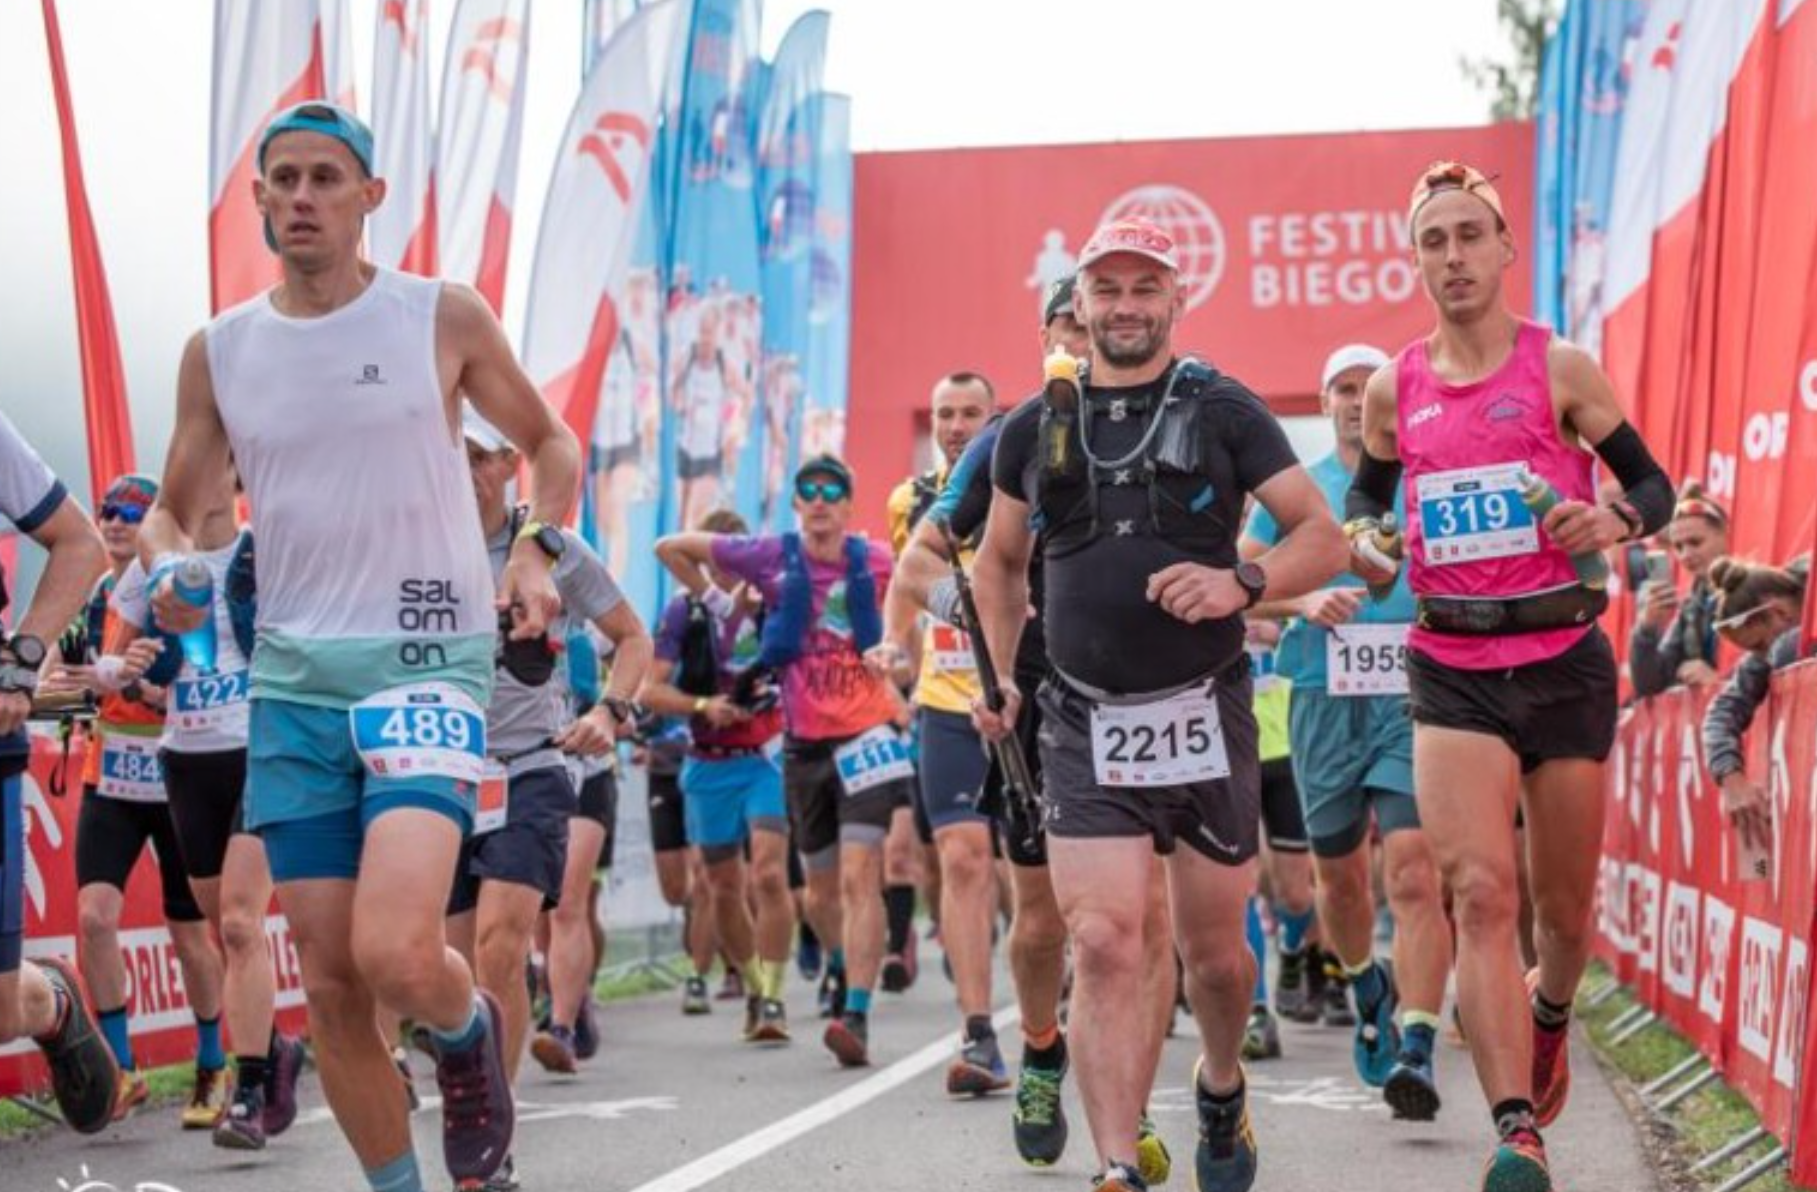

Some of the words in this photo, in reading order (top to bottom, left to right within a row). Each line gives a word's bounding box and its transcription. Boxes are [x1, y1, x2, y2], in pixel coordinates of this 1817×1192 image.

[1252, 259, 1419, 308] BIEGO
[1436, 493, 1510, 537] 319
[401, 641, 446, 665] on
[186, 674, 243, 709] 422
[380, 708, 471, 750] 489
[1104, 716, 1211, 762] 2215
[112, 752, 161, 780] 484
